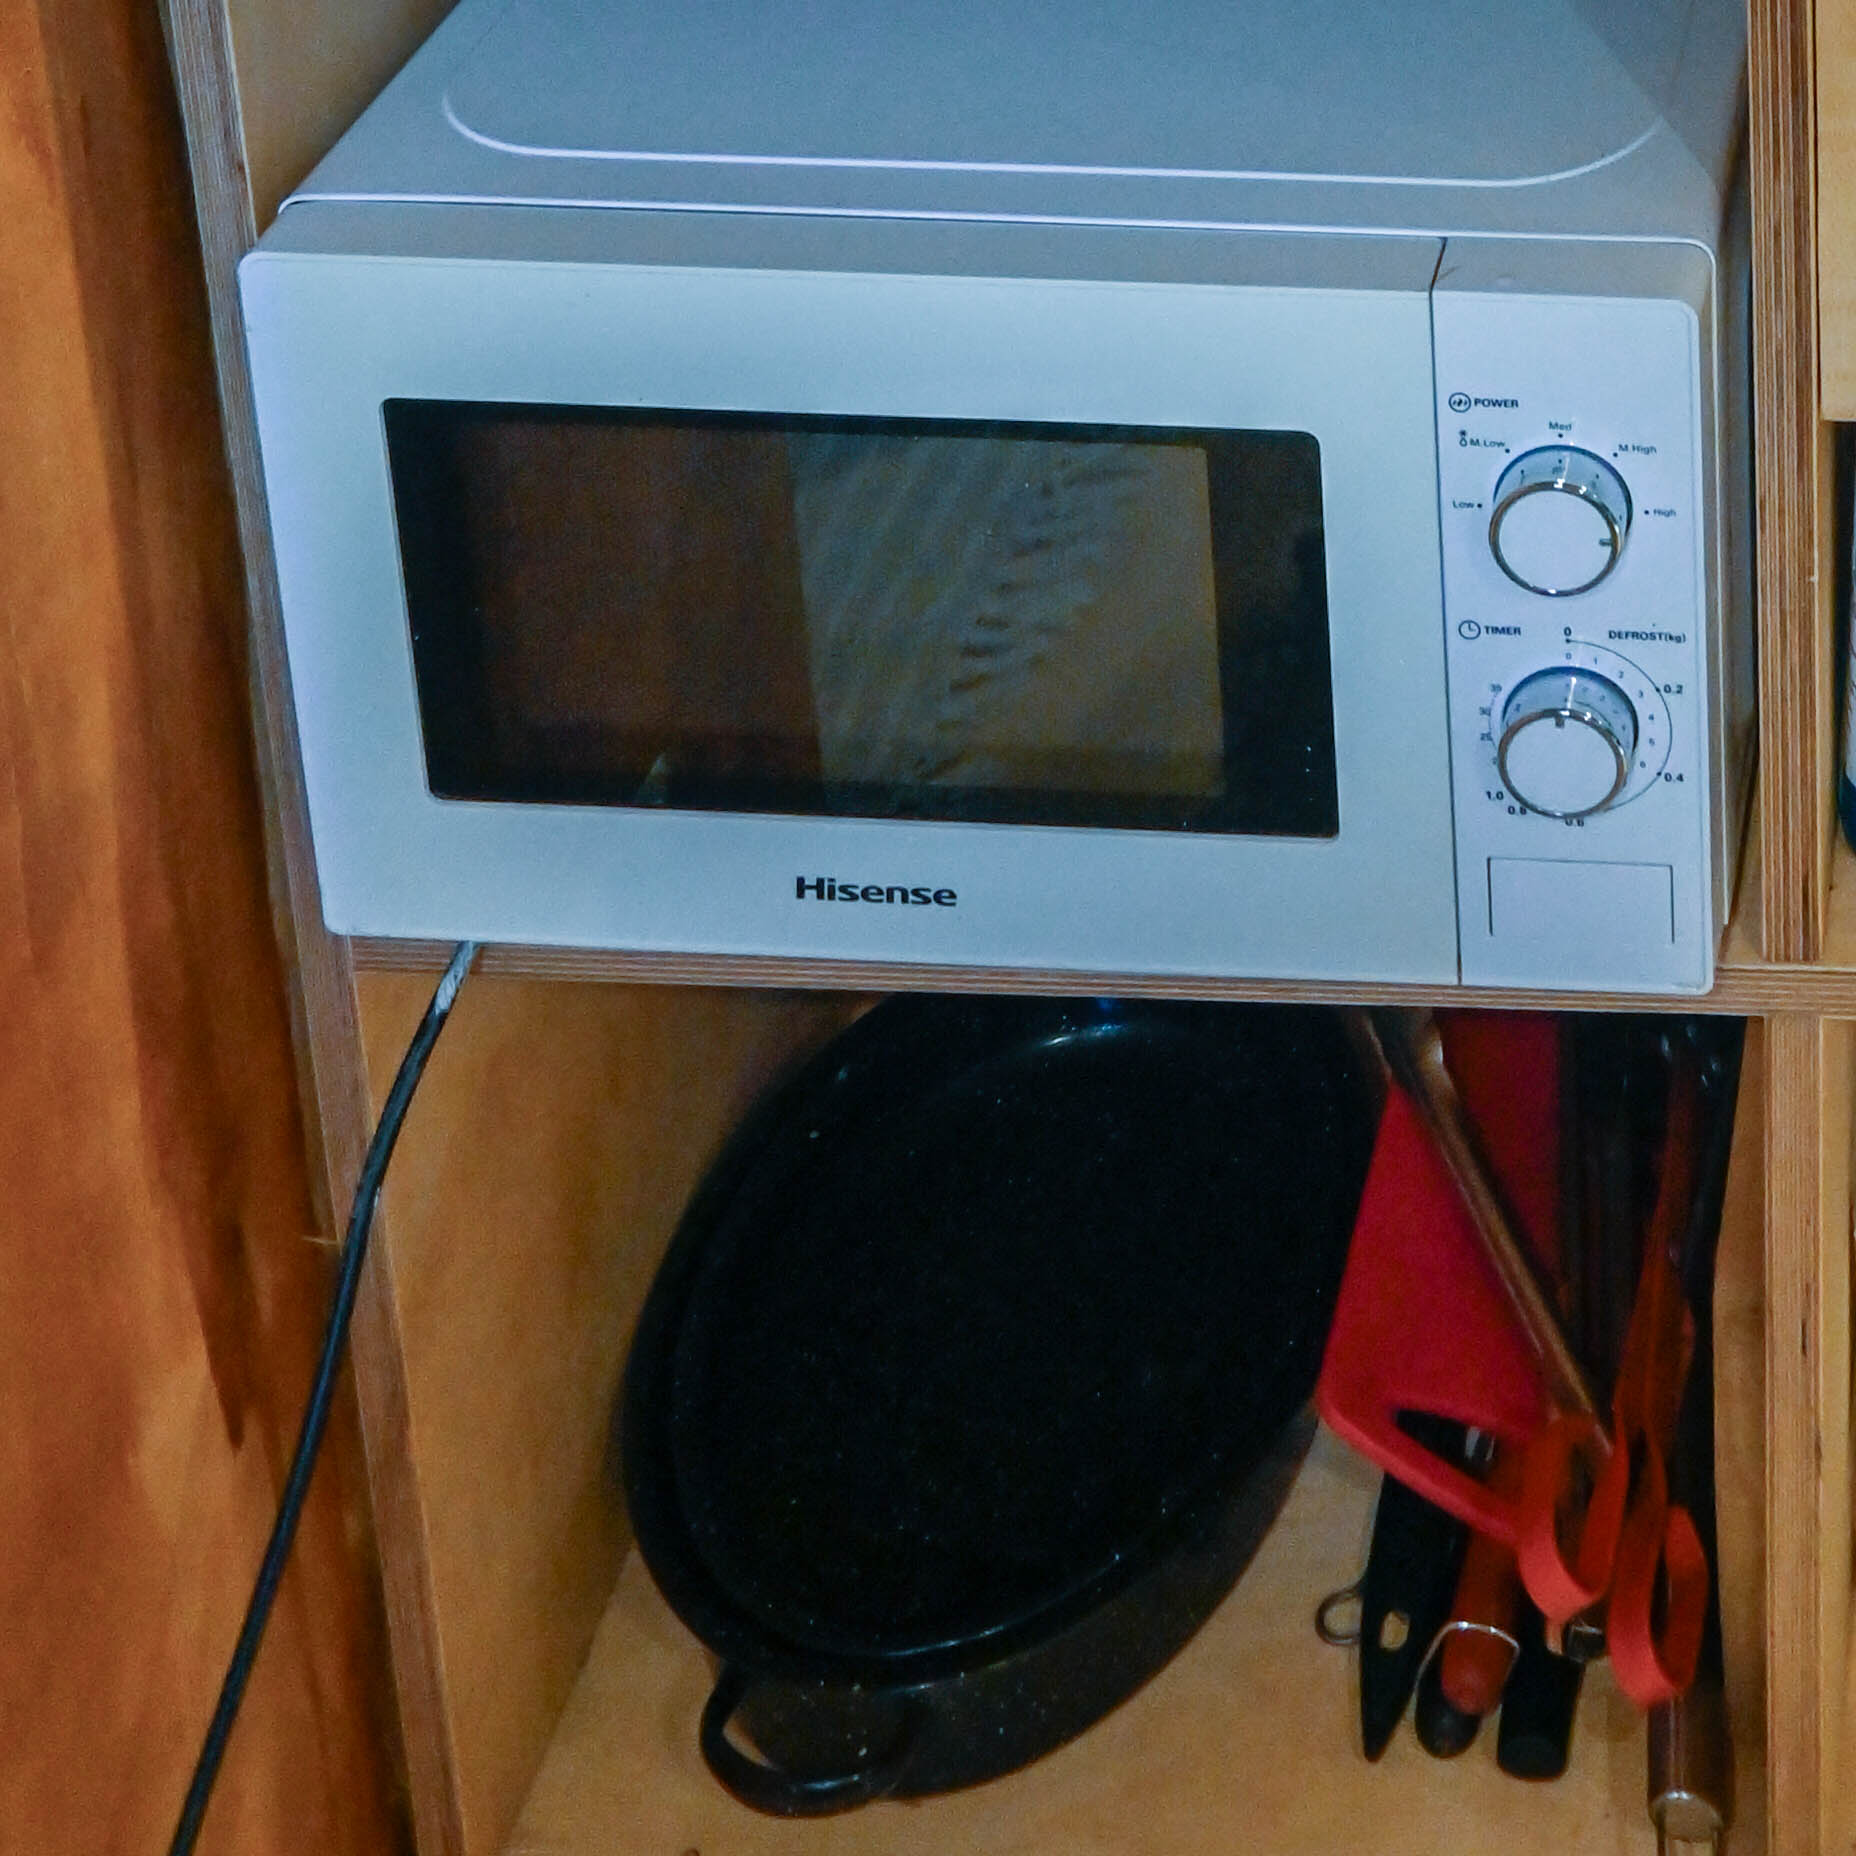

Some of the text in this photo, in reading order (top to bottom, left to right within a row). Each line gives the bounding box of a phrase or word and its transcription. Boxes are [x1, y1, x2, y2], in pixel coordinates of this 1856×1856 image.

[1473, 398, 1519, 409] POWER
[1548, 421, 1573, 432] Med
[1452, 500, 1475, 510] Low
[1653, 508, 1677, 518] High
[1483, 625, 1522, 636] TIMER
[1563, 626, 1573, 637] 0
[1663, 684, 1684, 695] 0.2
[1663, 772, 1685, 783] 0.4
[1486, 790, 1504, 801] 1.0
[795, 875, 958, 908] Hisense
